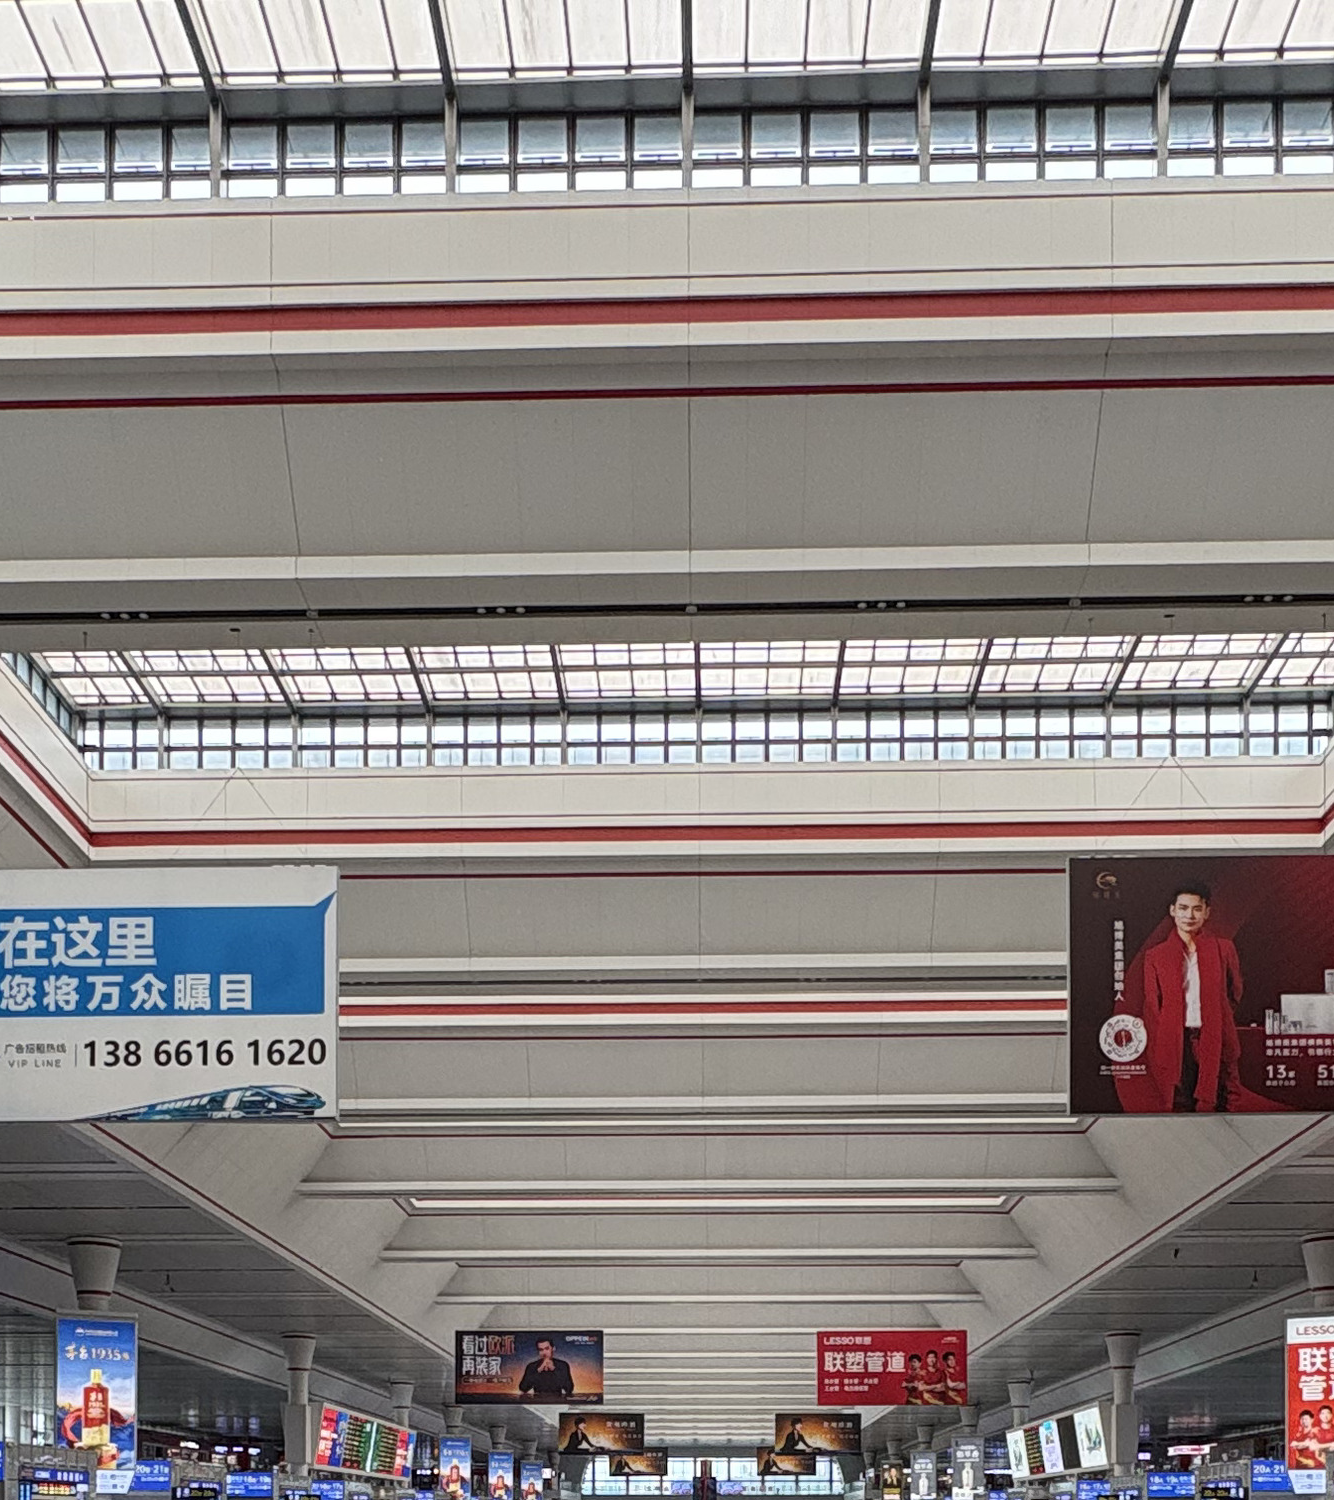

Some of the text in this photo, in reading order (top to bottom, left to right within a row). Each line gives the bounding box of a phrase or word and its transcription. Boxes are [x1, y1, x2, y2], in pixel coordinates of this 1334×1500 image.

[0, 974, 253, 1012] 您将万众瞩目
[83, 1039, 327, 1067] 138 6616 1620
[8, 1059, 62, 1068] VIP LINE
[462, 1335, 515, 1355] 看过欧派
[824, 1336, 854, 1345] LESSO
[462, 1357, 502, 1375] 再装家
[824, 1351, 906, 1373] 联塑管道
